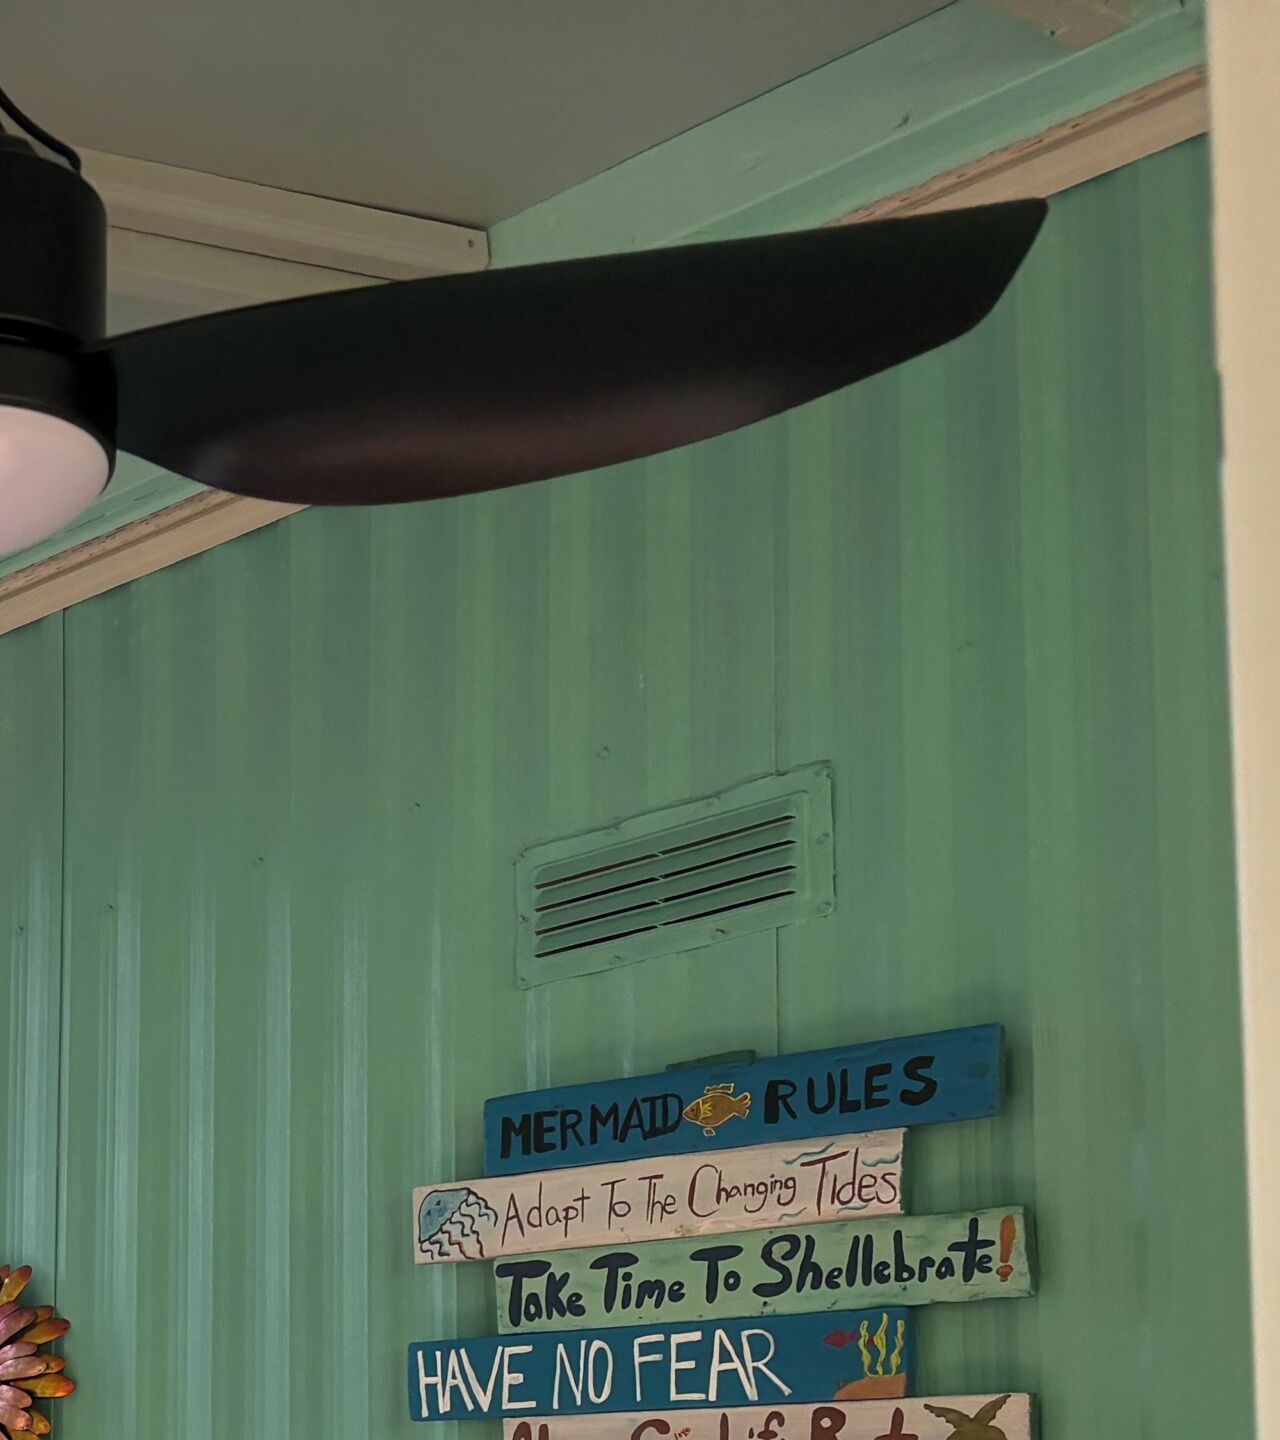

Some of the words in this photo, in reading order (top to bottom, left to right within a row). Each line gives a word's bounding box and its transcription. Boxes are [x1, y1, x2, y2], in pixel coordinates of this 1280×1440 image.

[499, 1093, 684, 1159] MERMAID
[763, 1055, 937, 1125] RULES
[500, 1181, 590, 1246] Adapt
[601, 1178, 632, 1232] To
[639, 1174, 678, 1230] The
[688, 1163, 797, 1218] Changing
[801, 1149, 898, 1224] Tides
[495, 1253, 586, 1328] Take
[589, 1250, 686, 1311] Time
[690, 1244, 742, 1303] To
[753, 1214, 1016, 1299] Shellebrate!
[416, 1344, 537, 1419] HAVE
[552, 1339, 614, 1409] NO
[634, 1327, 793, 1403] FEAR
